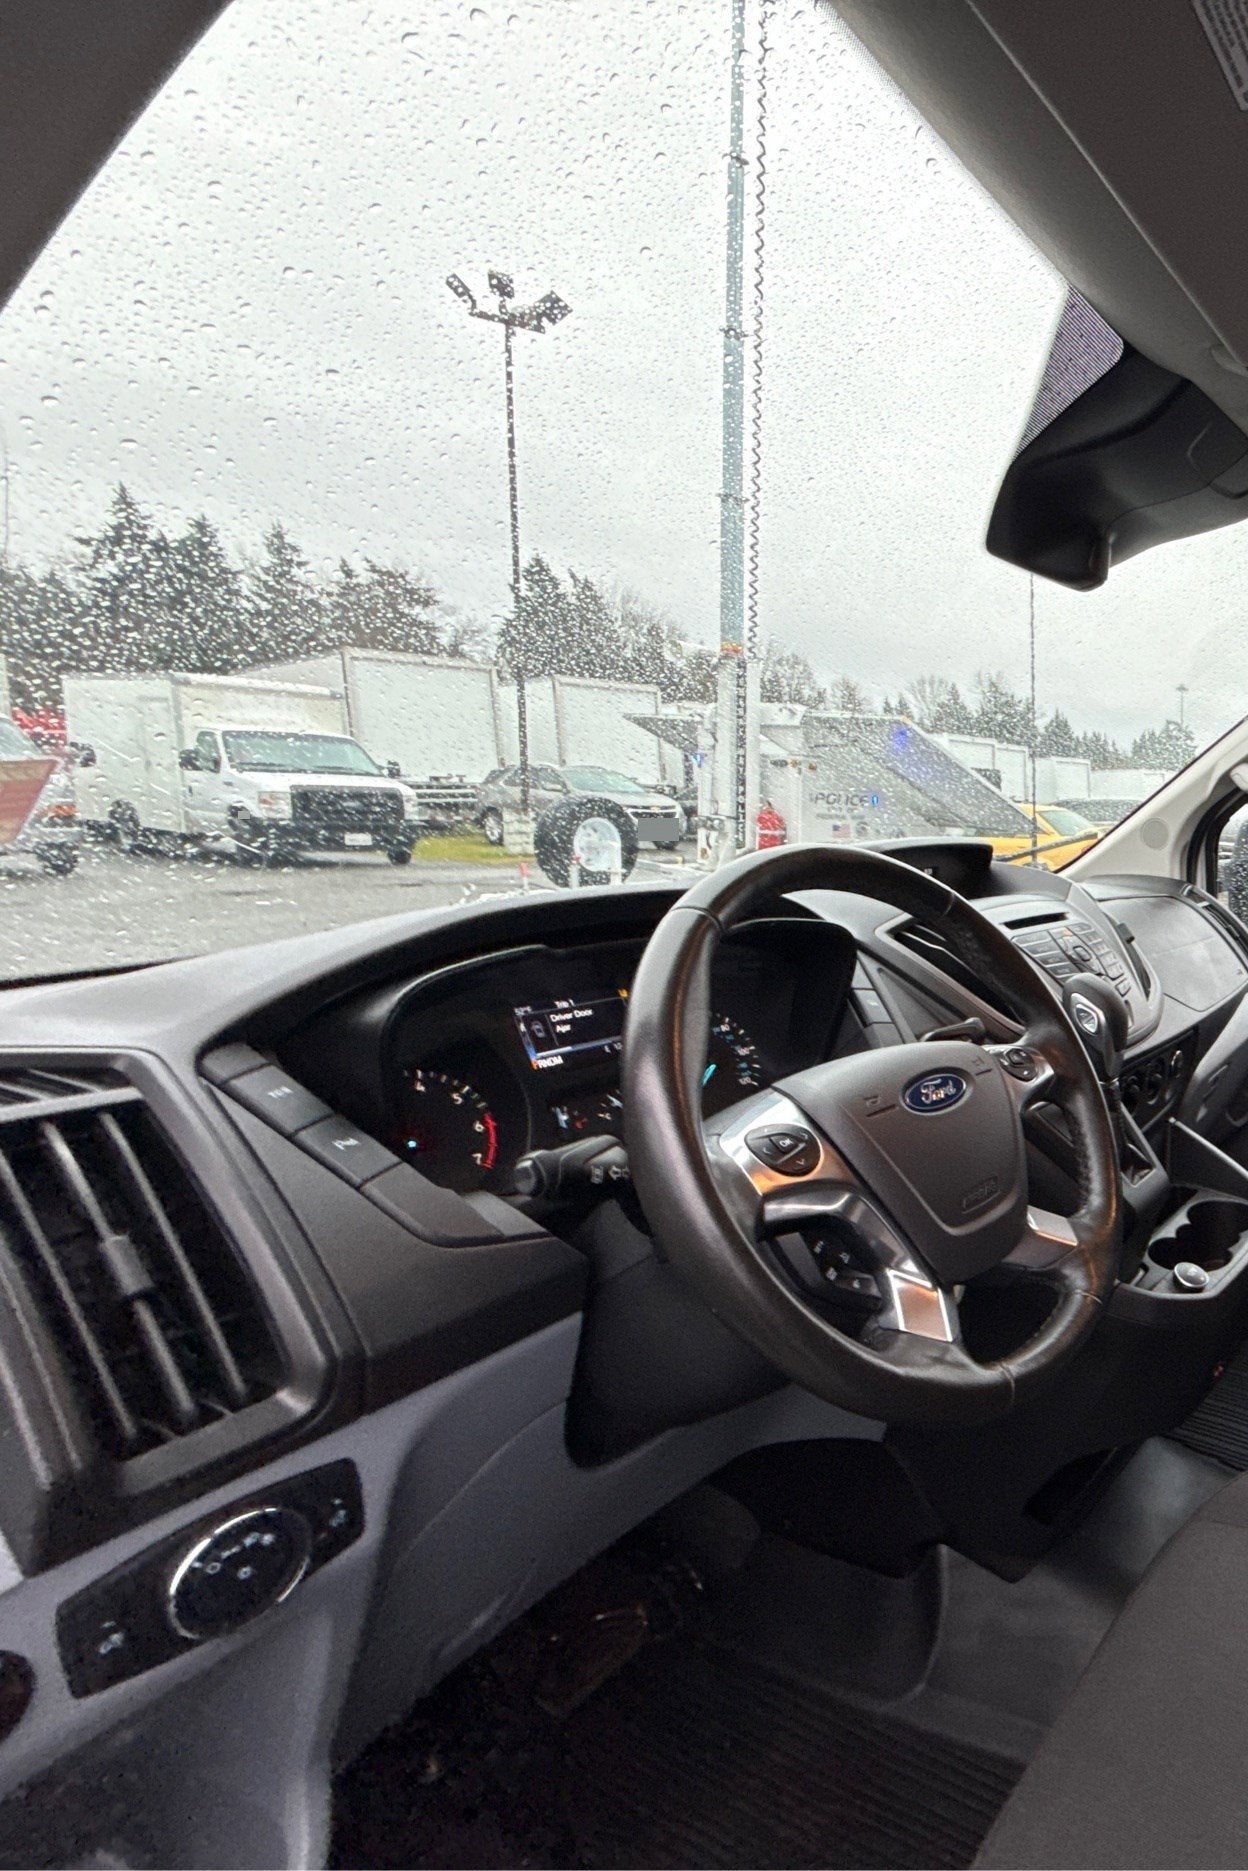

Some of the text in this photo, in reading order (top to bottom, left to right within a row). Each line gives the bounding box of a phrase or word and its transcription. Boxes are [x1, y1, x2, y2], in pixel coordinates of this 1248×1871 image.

[814, 793, 868, 807] POLICE
[550, 1009, 593, 1022] Driver Door
[556, 1024, 571, 1033] Ajar
[415, 1081, 425, 1092] 4
[920, 1078, 957, 1105] Ford
[452, 1093, 463, 1104] 5
[474, 1121, 484, 1132] 6
[779, 1138, 794, 1148] OK
[472, 1153, 482, 1165] 7
